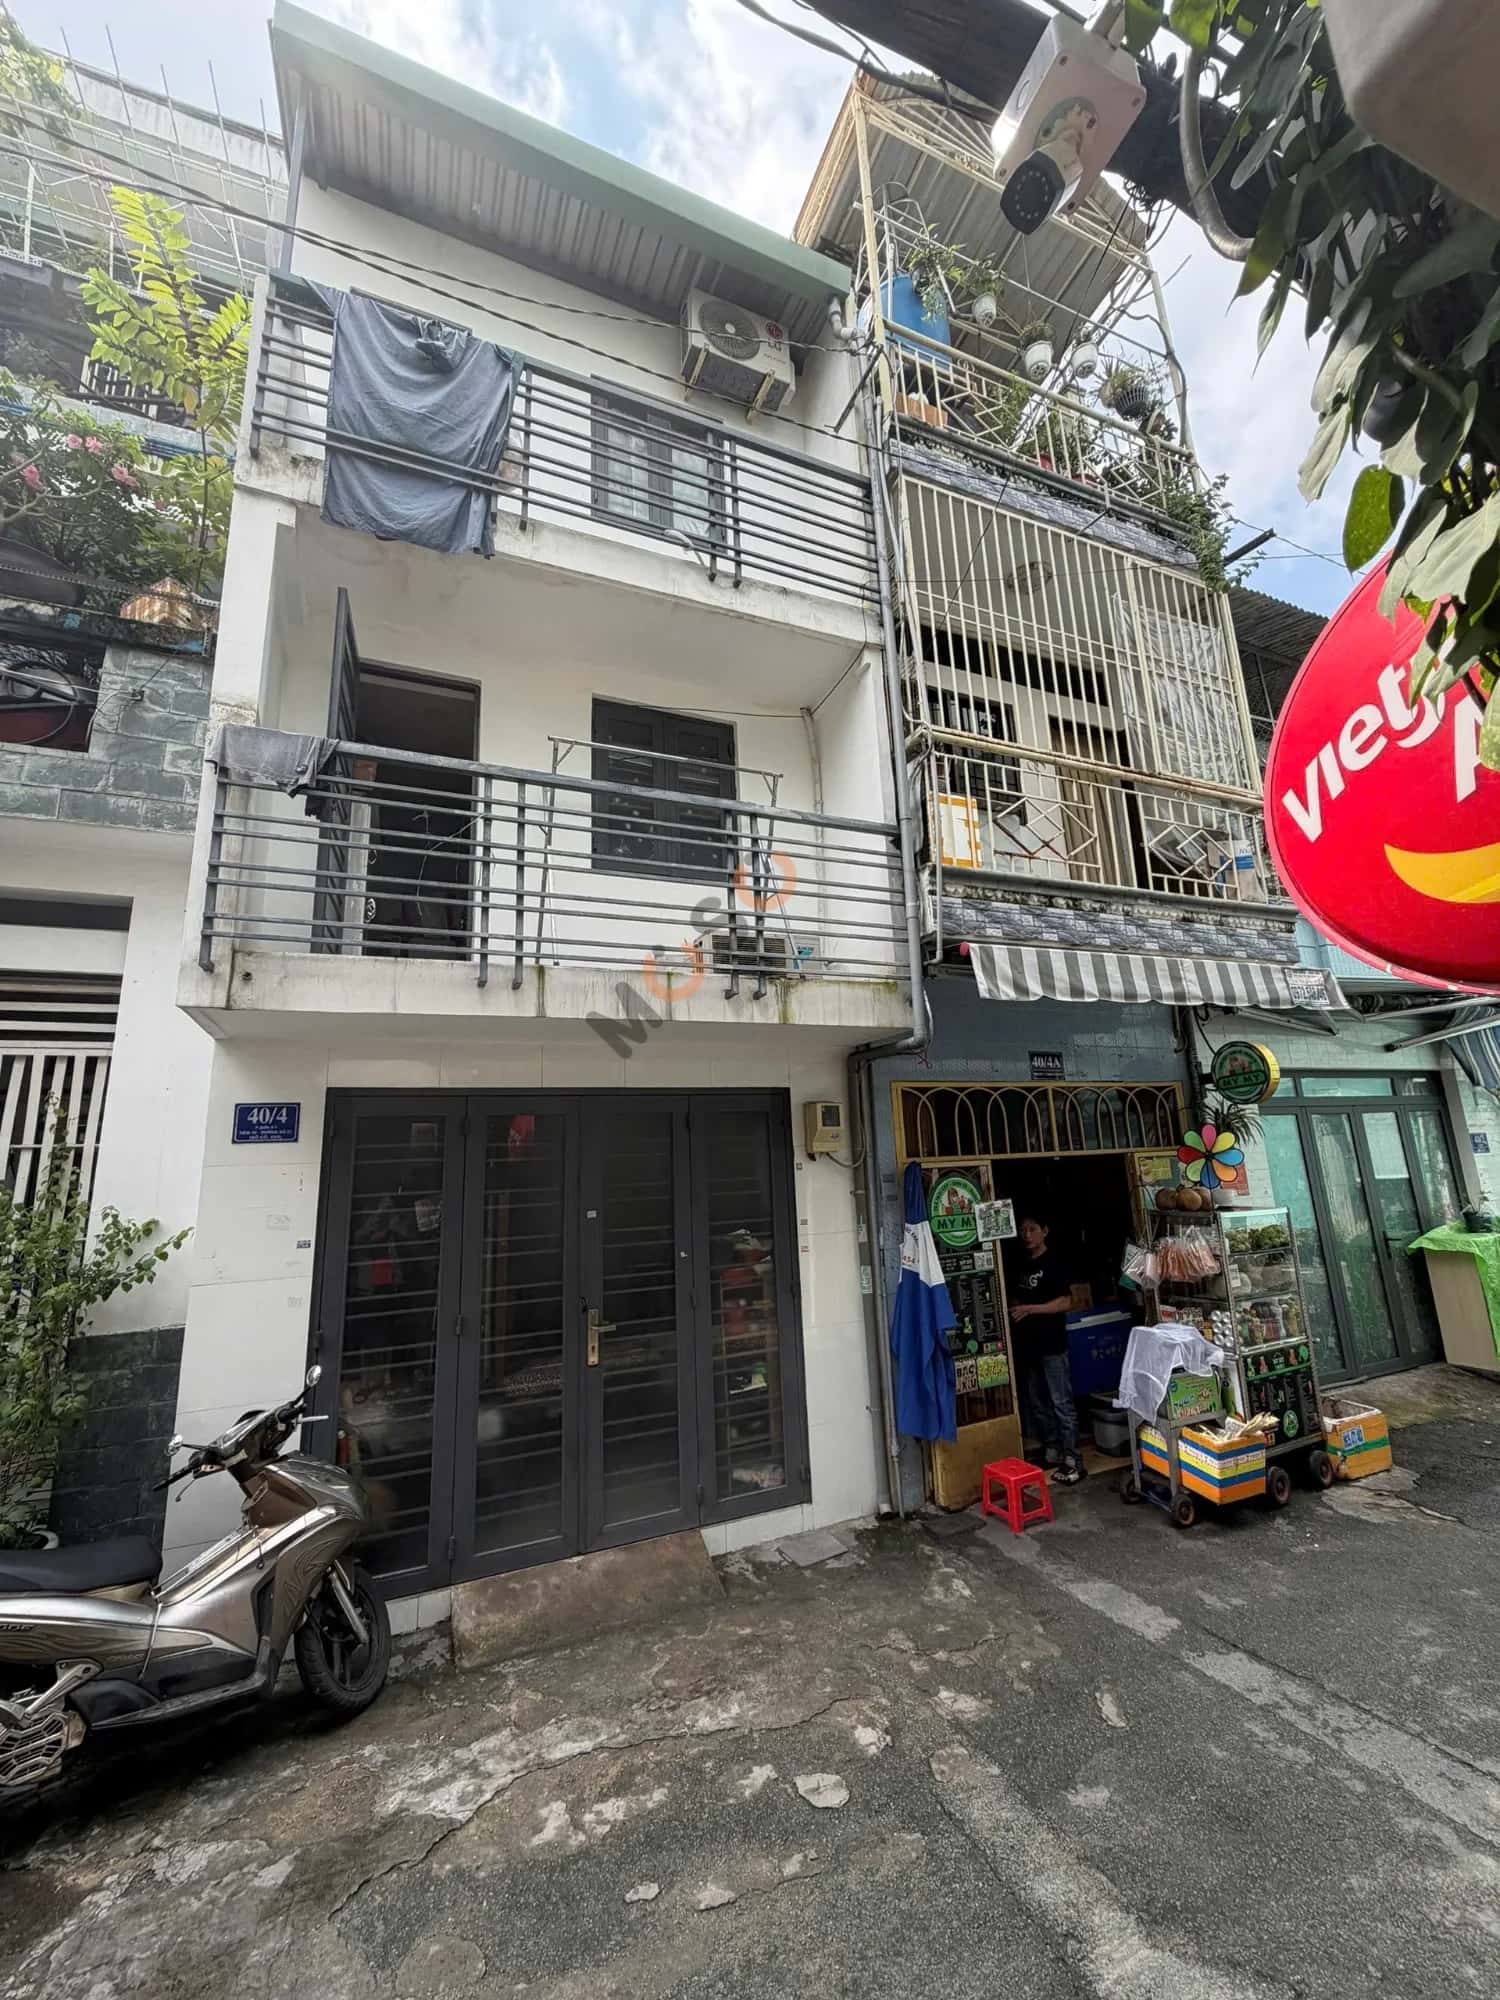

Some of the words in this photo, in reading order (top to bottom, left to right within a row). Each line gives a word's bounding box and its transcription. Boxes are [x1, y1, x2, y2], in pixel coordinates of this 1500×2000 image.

[1031, 1055, 1061, 1068] 40/4A
[247, 1107, 288, 1125] 40/4
[937, 1218, 957, 1230] MY
